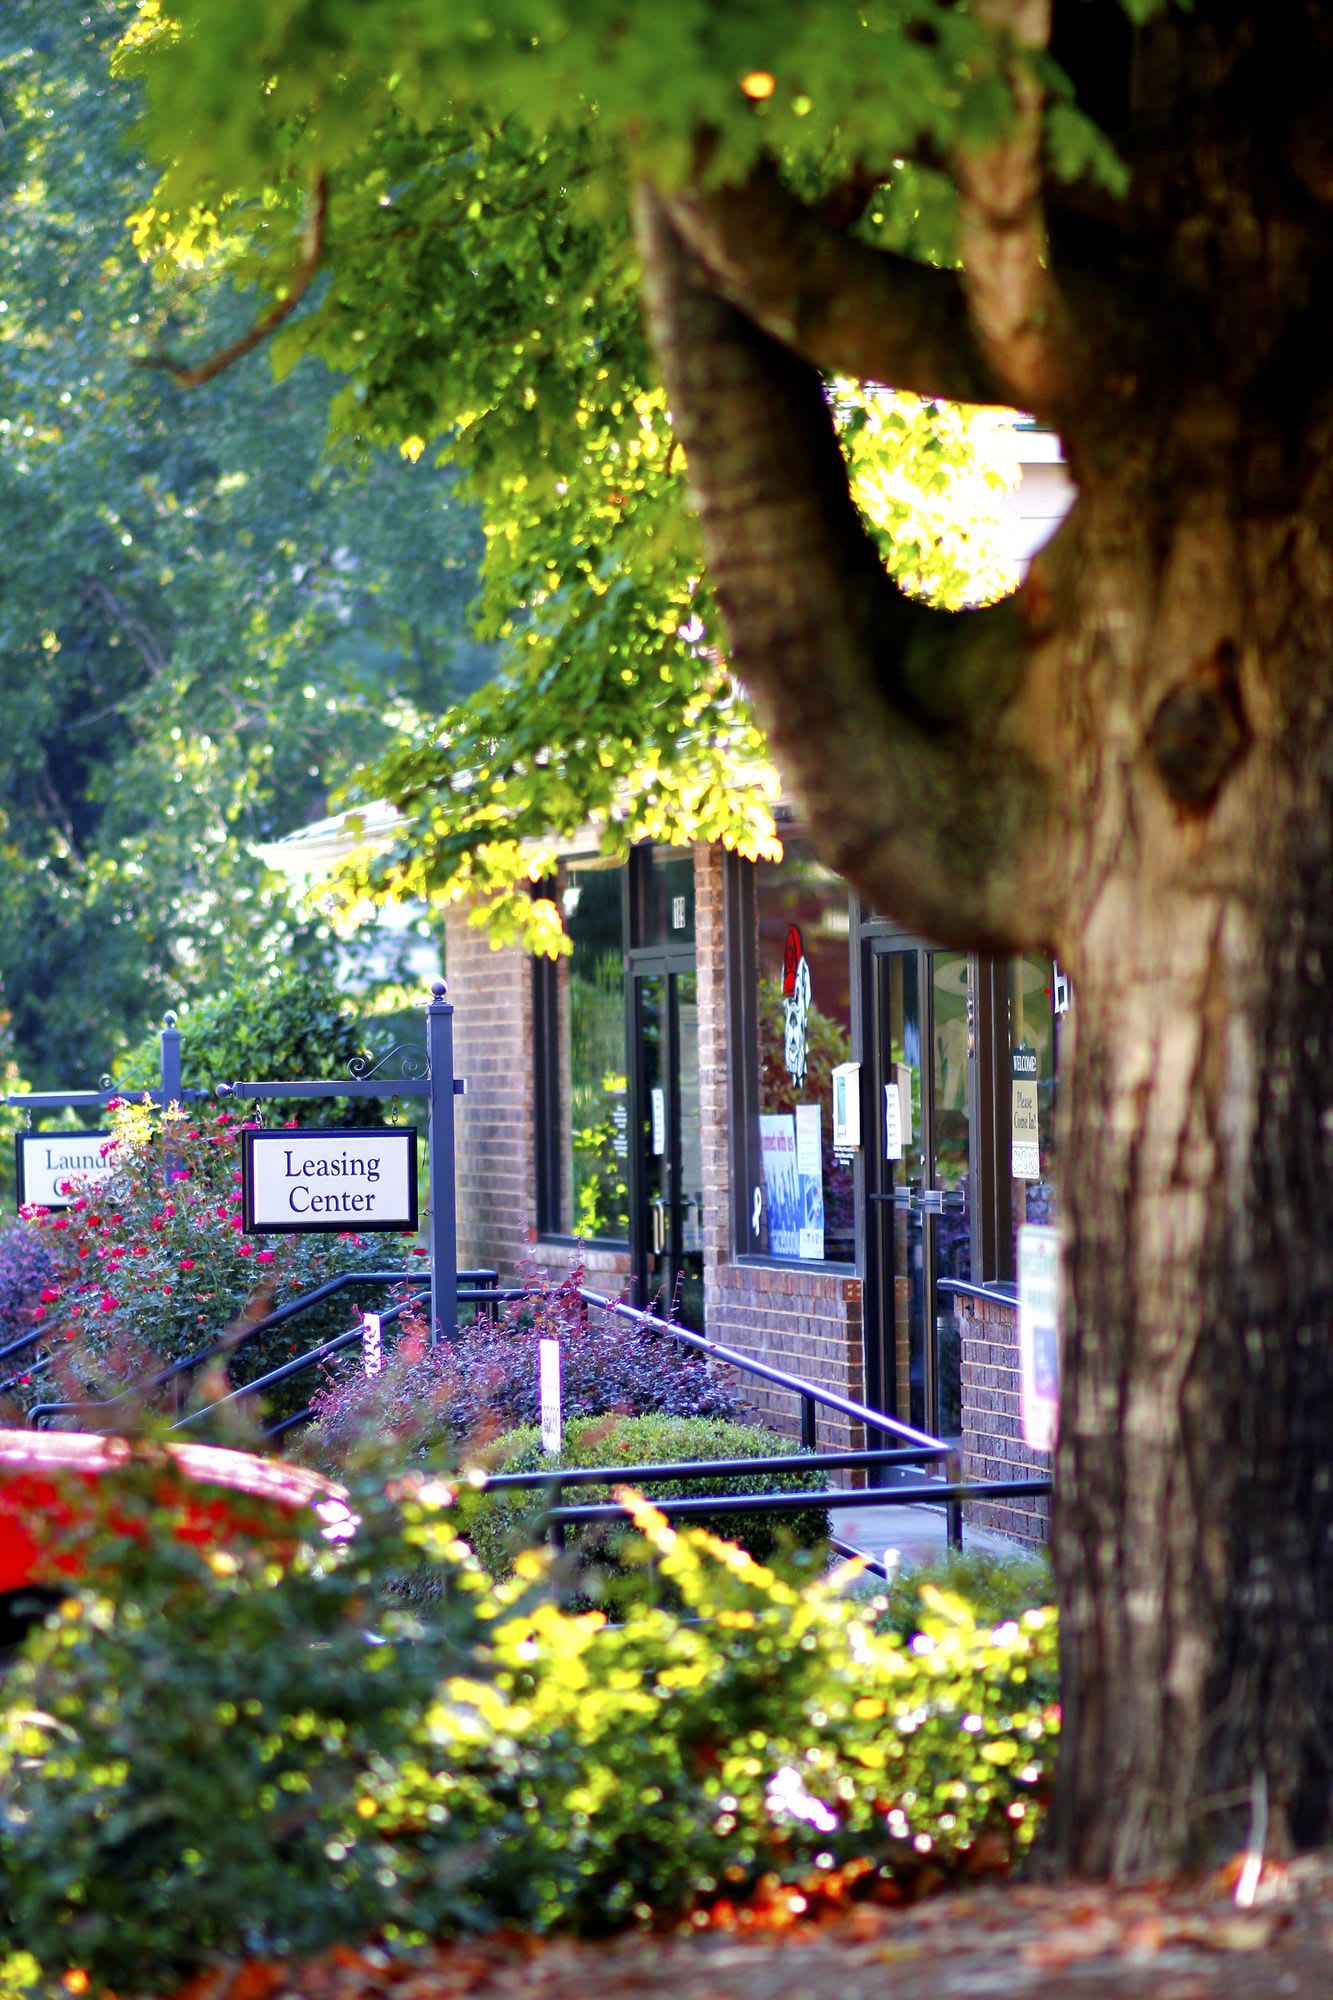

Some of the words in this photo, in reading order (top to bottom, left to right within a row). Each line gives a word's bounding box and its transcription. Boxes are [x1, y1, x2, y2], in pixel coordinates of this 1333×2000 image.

[1016, 1091, 1033, 1109] Please
[1013, 1111, 1028, 1129] Come
[283, 1150, 381, 1182] Leasing
[288, 1185, 376, 1213] Center
